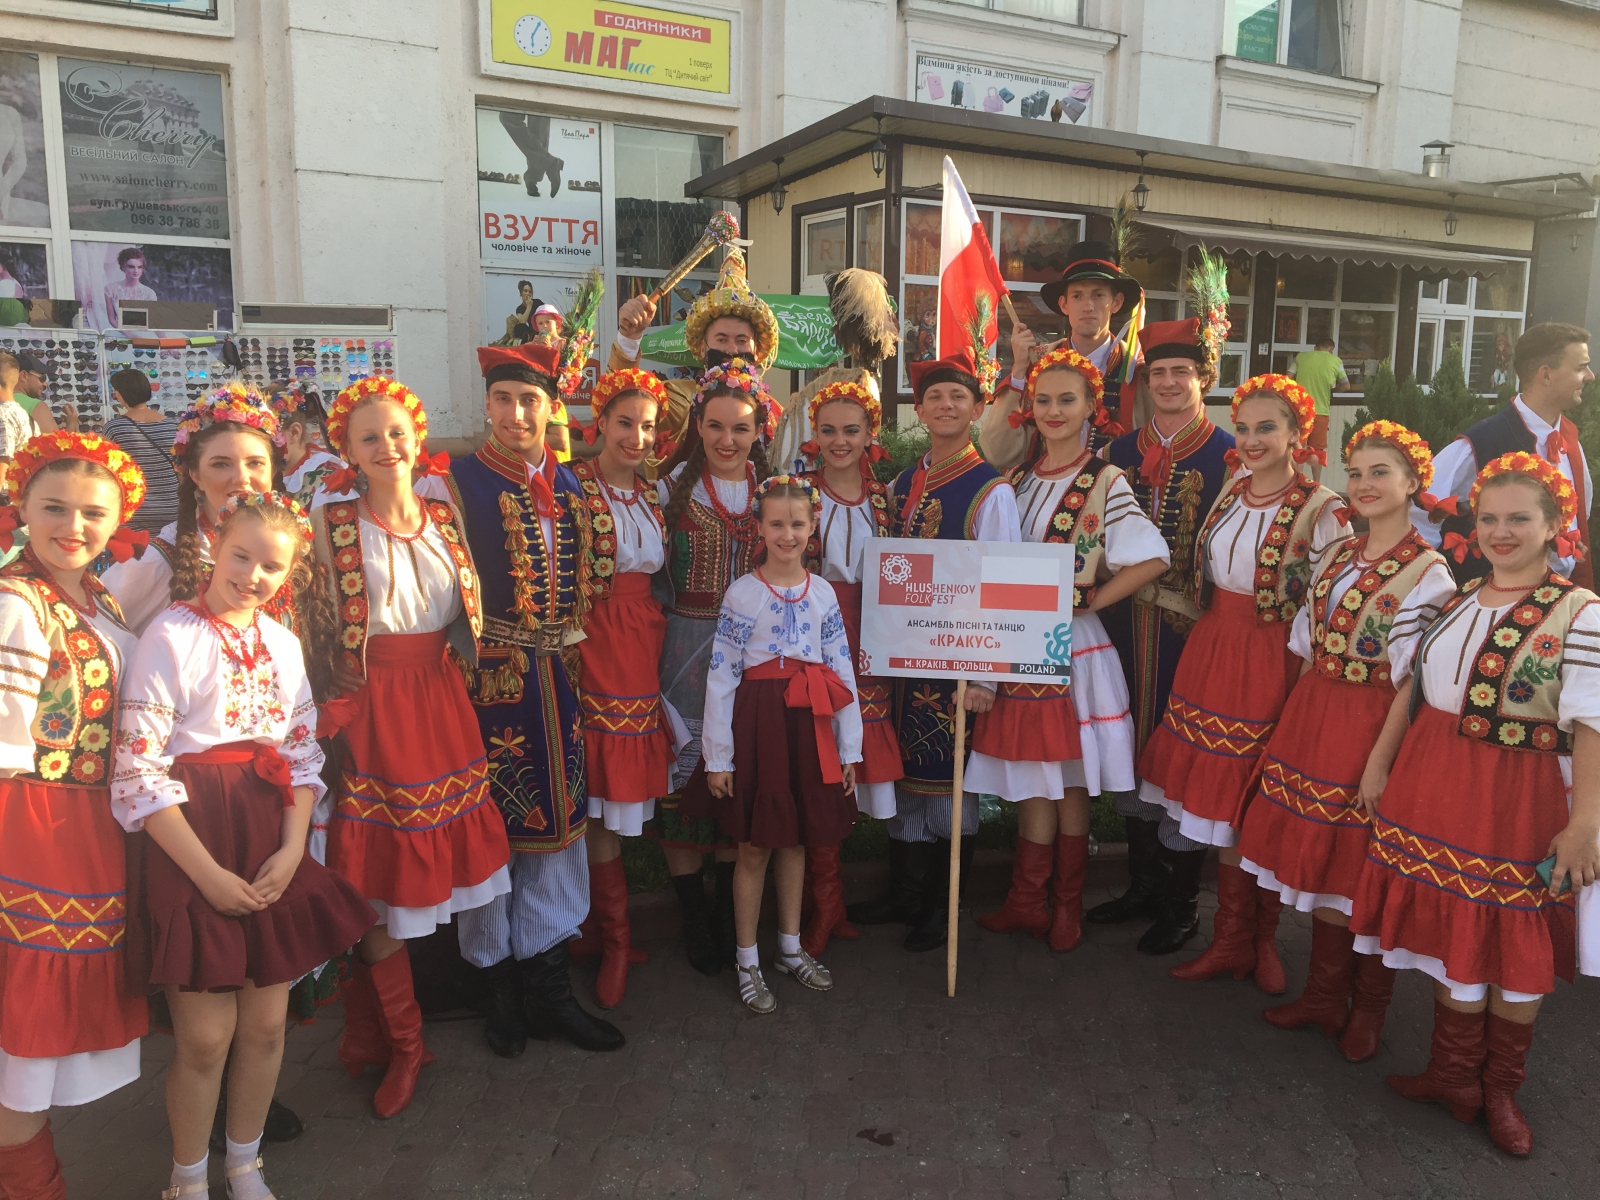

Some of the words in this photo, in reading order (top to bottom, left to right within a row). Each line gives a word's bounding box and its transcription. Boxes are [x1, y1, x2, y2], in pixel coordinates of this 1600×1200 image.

[605, 14, 702, 40] ГОДИННИКИ
[564, 30, 642, 71] МАГ
[693, 58, 713, 70] поверх
[665, 69, 673, 79] ТЦ
[918, 56, 955, 71] Відмінна
[957, 64, 982, 75] якість
[993, 70, 1040, 84] доступними
[1041, 77, 1070, 89] цінами!
[92, 92, 217, 169] Cherry
[70, 146, 139, 162] ВЕСІЛЬНИЙ
[142, 153, 185, 166] САЛОН
[204, 204, 219, 215] 40
[131, 213, 155, 226] 096
[159, 215, 174, 227] 38
[205, 218, 220, 230] 38
[484, 212, 599, 245] ВЗУТТЯ
[492, 243, 539, 253] чоловіче
[542, 246, 552, 254] та
[556, 246, 591, 256] жіноче
[905, 582, 976, 595] HLUSHENKOV
[904, 593, 956, 605] FOLKFEST
[907, 619, 954, 630] АНСАМБЛЬ
[956, 620, 981, 630] ПІСНІ
[982, 622, 993, 631] ТА
[994, 622, 1026, 633] ТАНЦЮ
[929, 634, 1001, 649] «КРАКУС»
[904, 659, 914, 668] М.
[916, 660, 950, 671] КРАКІВ,
[953, 661, 993, 673] ПОЛЬЩА
[1019, 664, 1056, 675] POLAND
